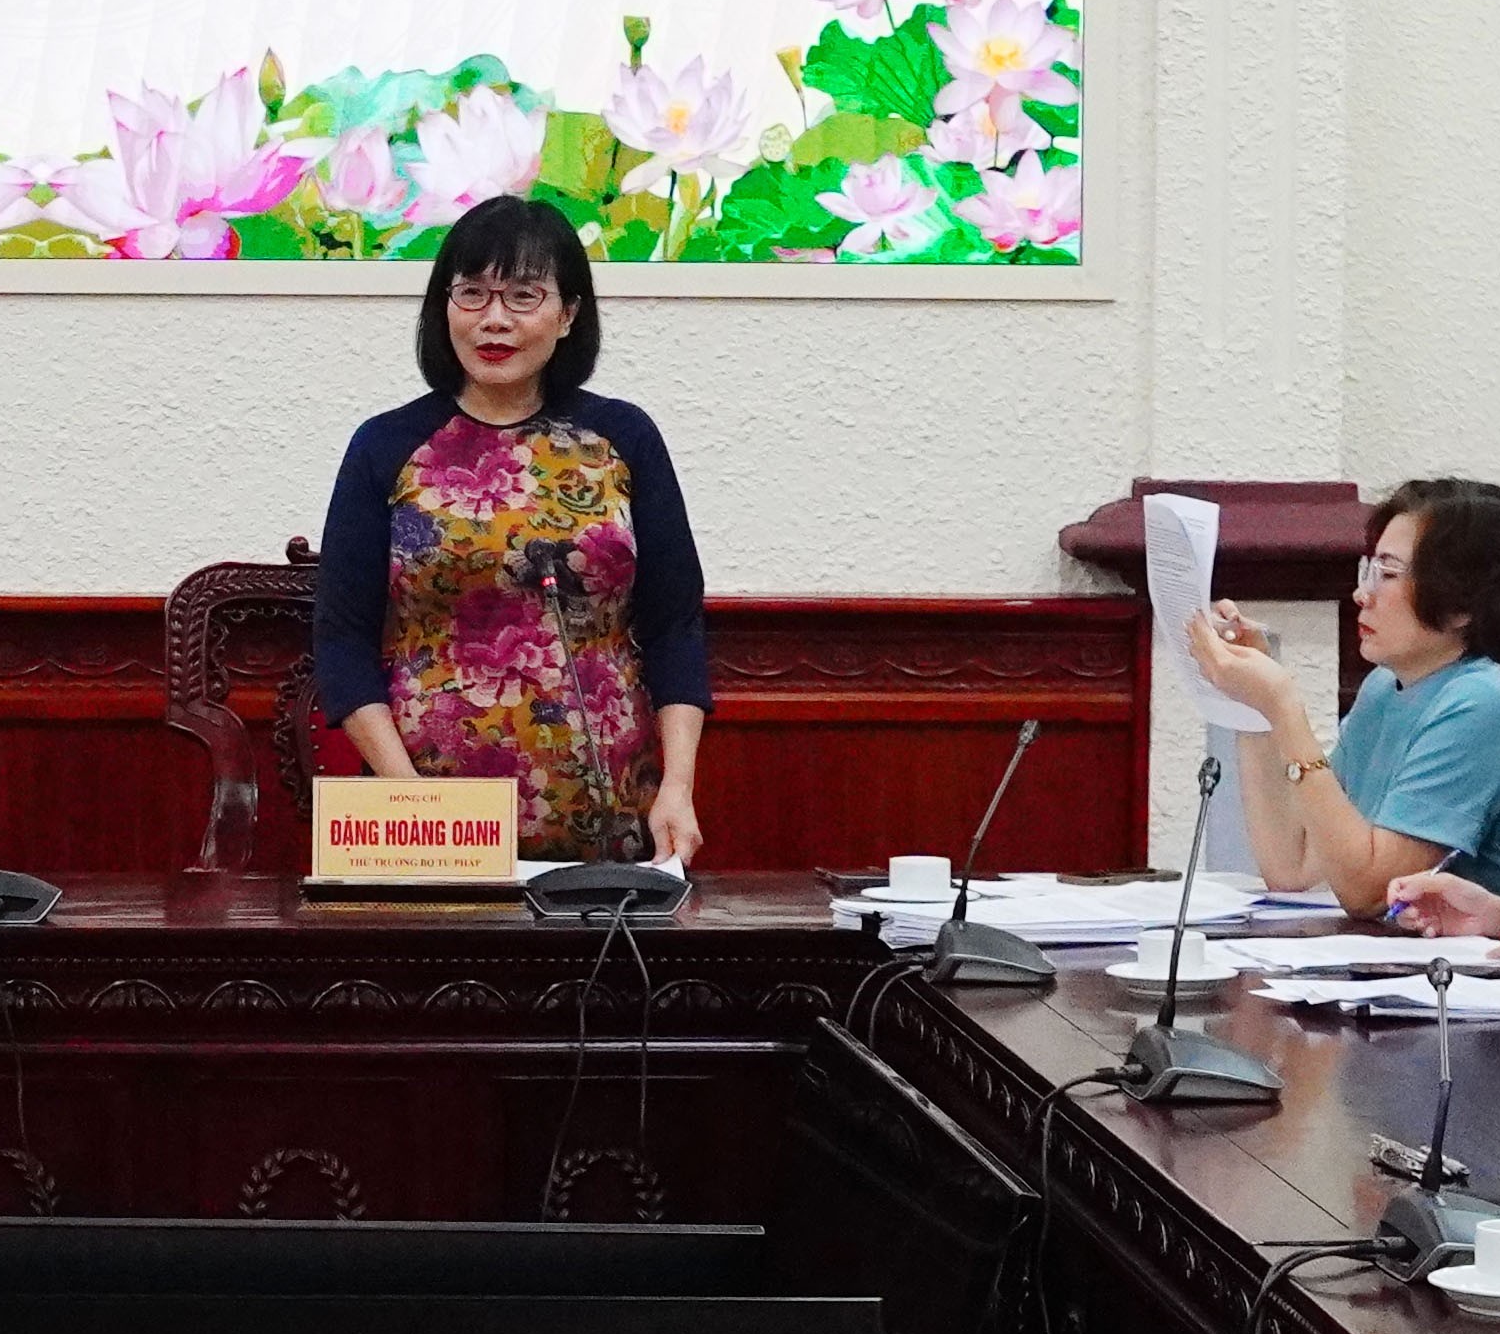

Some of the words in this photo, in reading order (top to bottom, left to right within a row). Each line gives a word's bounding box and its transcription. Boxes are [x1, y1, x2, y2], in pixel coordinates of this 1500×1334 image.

[330, 814, 380, 852] ĐẶNG
[385, 814, 446, 847] HOÀNG
[451, 820, 501, 847] OANH
